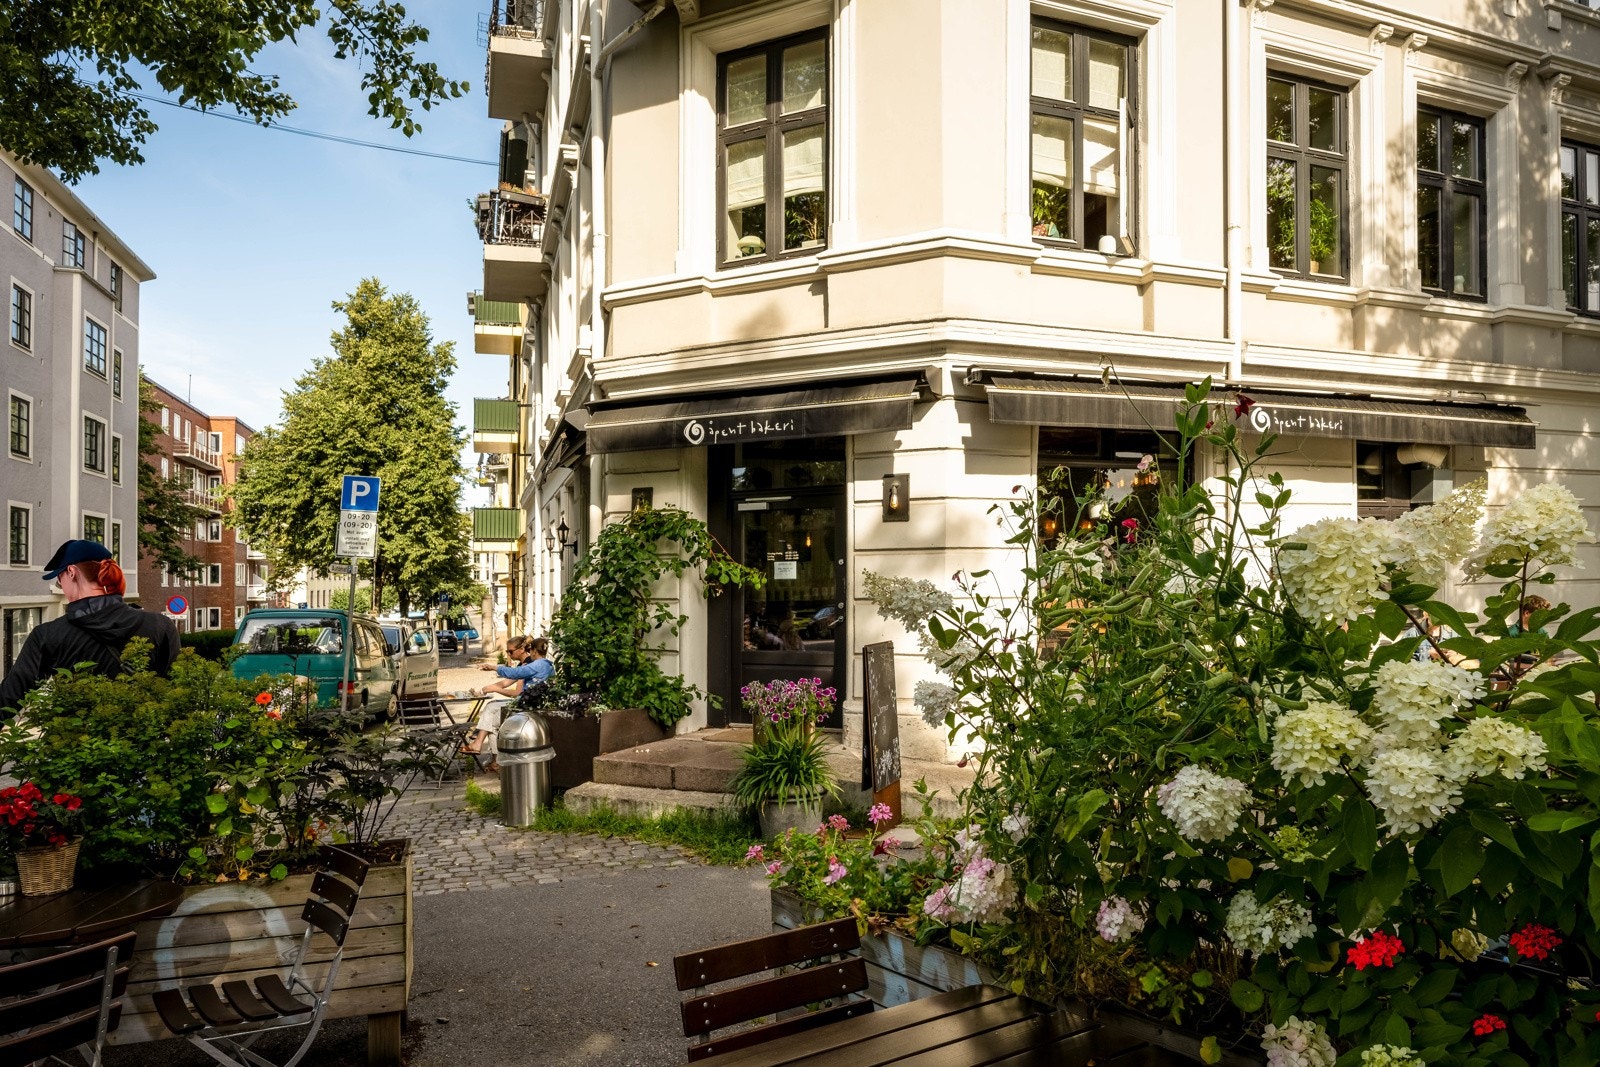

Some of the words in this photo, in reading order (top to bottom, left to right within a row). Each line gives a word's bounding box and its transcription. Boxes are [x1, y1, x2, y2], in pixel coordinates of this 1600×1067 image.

[709, 420, 746, 444] åpent
[751, 419, 794, 434] bakeri
[1273, 409, 1306, 434] åpent
[1309, 416, 1343, 431] bakeri
[350, 480, 371, 506] P
